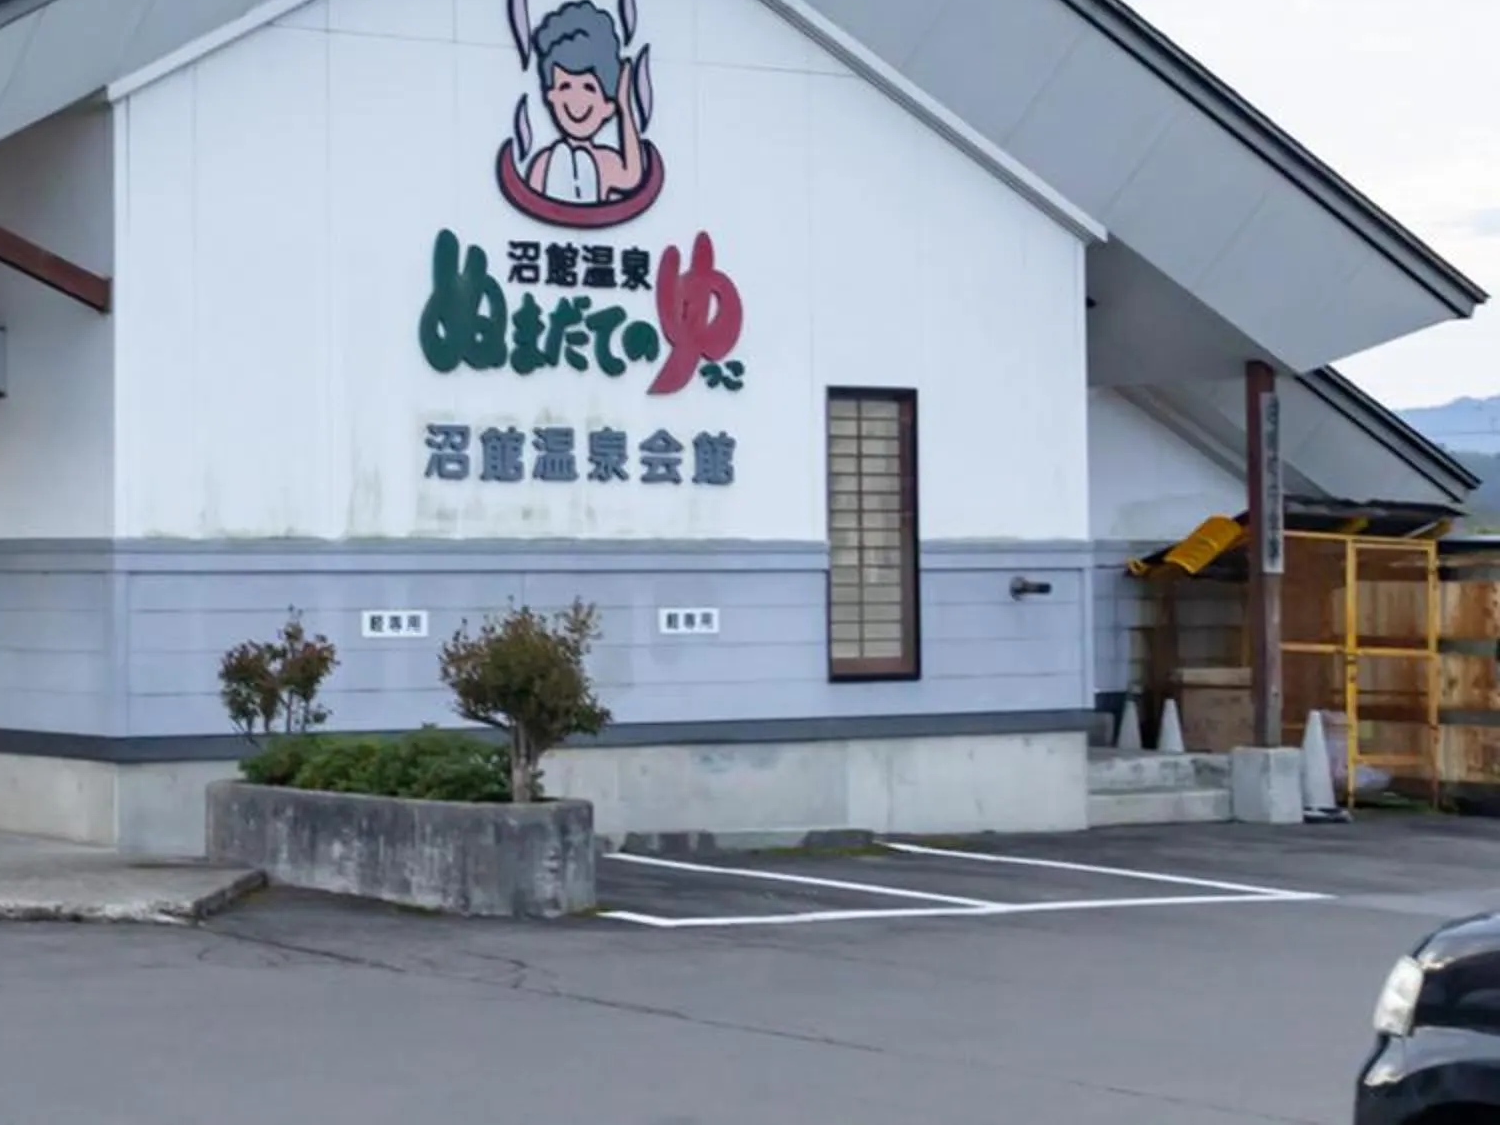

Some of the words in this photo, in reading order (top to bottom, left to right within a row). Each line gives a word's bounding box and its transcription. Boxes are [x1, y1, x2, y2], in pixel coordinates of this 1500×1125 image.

[507, 240, 652, 291] 沼館温泉
[424, 424, 737, 485] 沼館温泉会館
